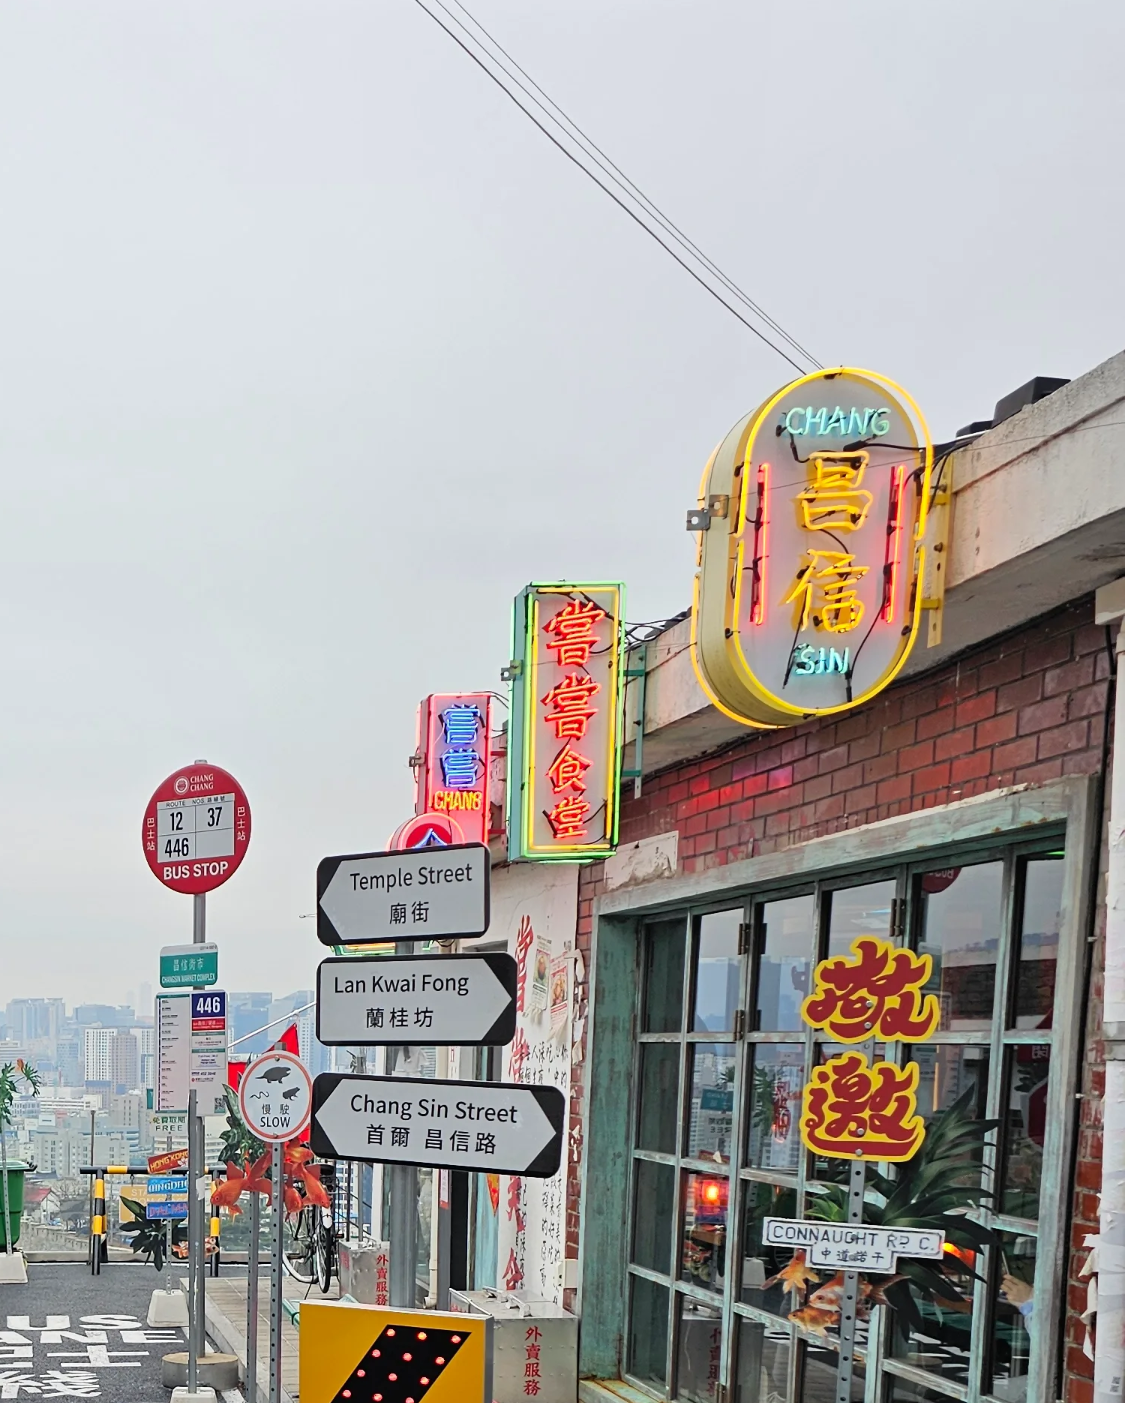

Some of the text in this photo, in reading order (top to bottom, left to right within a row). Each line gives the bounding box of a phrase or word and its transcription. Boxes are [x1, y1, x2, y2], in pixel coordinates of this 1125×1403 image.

[785, 406, 891, 436] CHANG
[796, 646, 850, 675] SIN
[190, 774, 214, 784] CHANG
[190, 782, 214, 792] CHANG
[169, 807, 223, 831] 12 37
[165, 838, 189, 858] 446
[163, 861, 229, 880] BUS STOP
[350, 863, 473, 893] Temple Street
[389, 901, 430, 925] 廟街
[334, 974, 469, 996] Lan Kwai Fong
[196, 997, 220, 1014] 446
[365, 1007, 434, 1029] 蘭桂坊
[350, 1094, 518, 1124] Chang Sin Street
[260, 1117, 290, 1128] SLOW
[424, 1128, 497, 1155] 昌信路
[150, 1157, 169, 1172] HONG
[773, 1223, 878, 1247] CONNAUGHT
[524, 1326, 542, 1396] 外賣服務
